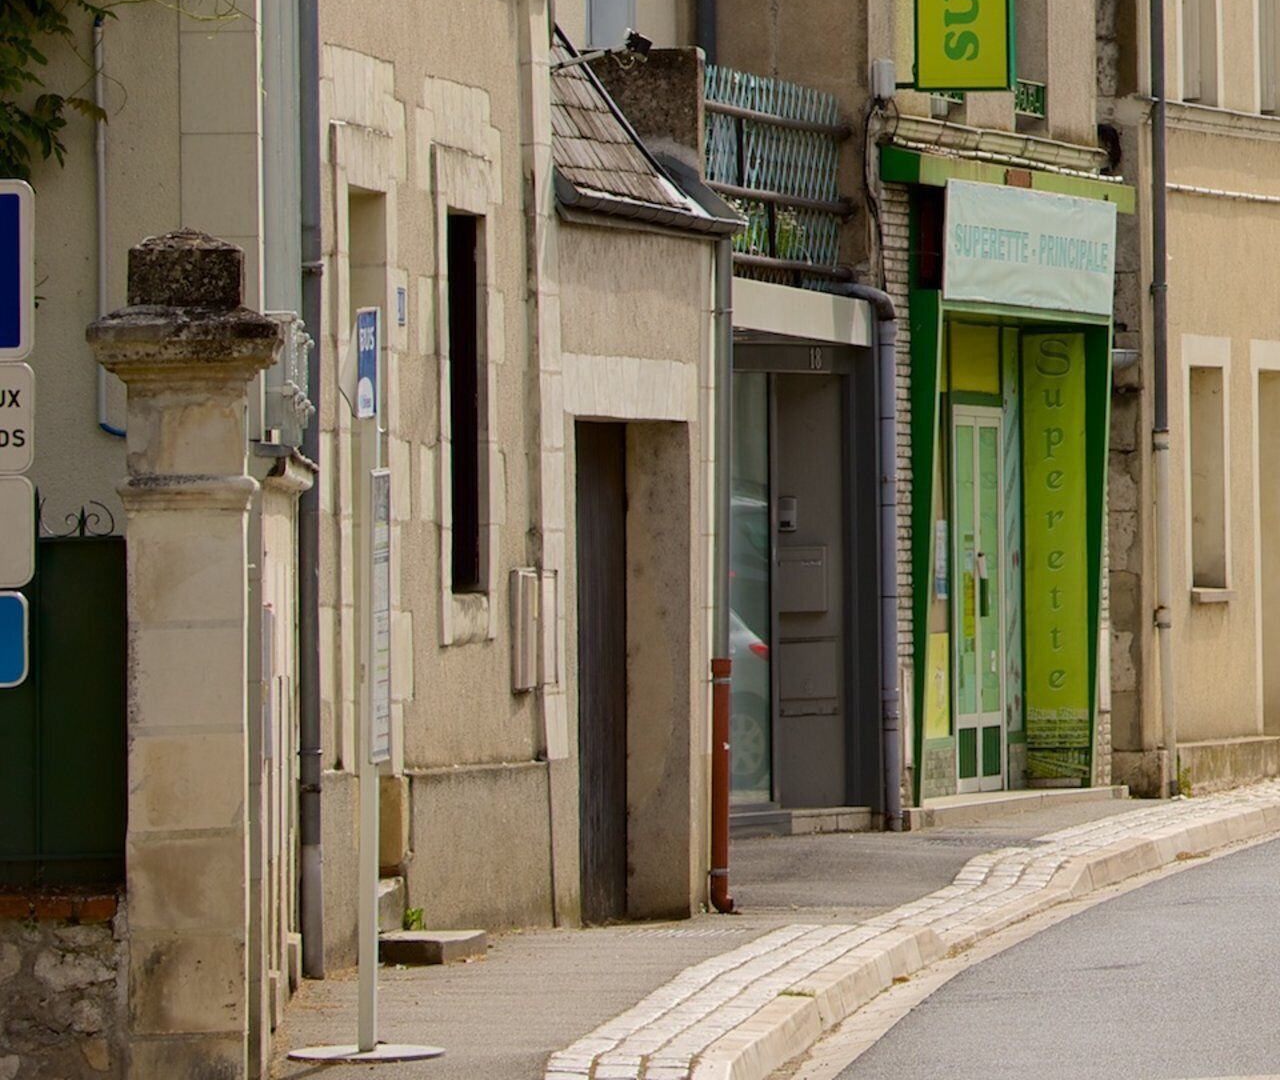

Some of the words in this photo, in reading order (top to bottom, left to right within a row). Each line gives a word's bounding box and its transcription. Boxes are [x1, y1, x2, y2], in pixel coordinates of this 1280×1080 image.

[955, 223, 1030, 263] SUPERETTE
[1039, 234, 1109, 273] PRINCIPALE
[811, 347, 822, 369] 18
[1034, 338, 1071, 690] Superette
